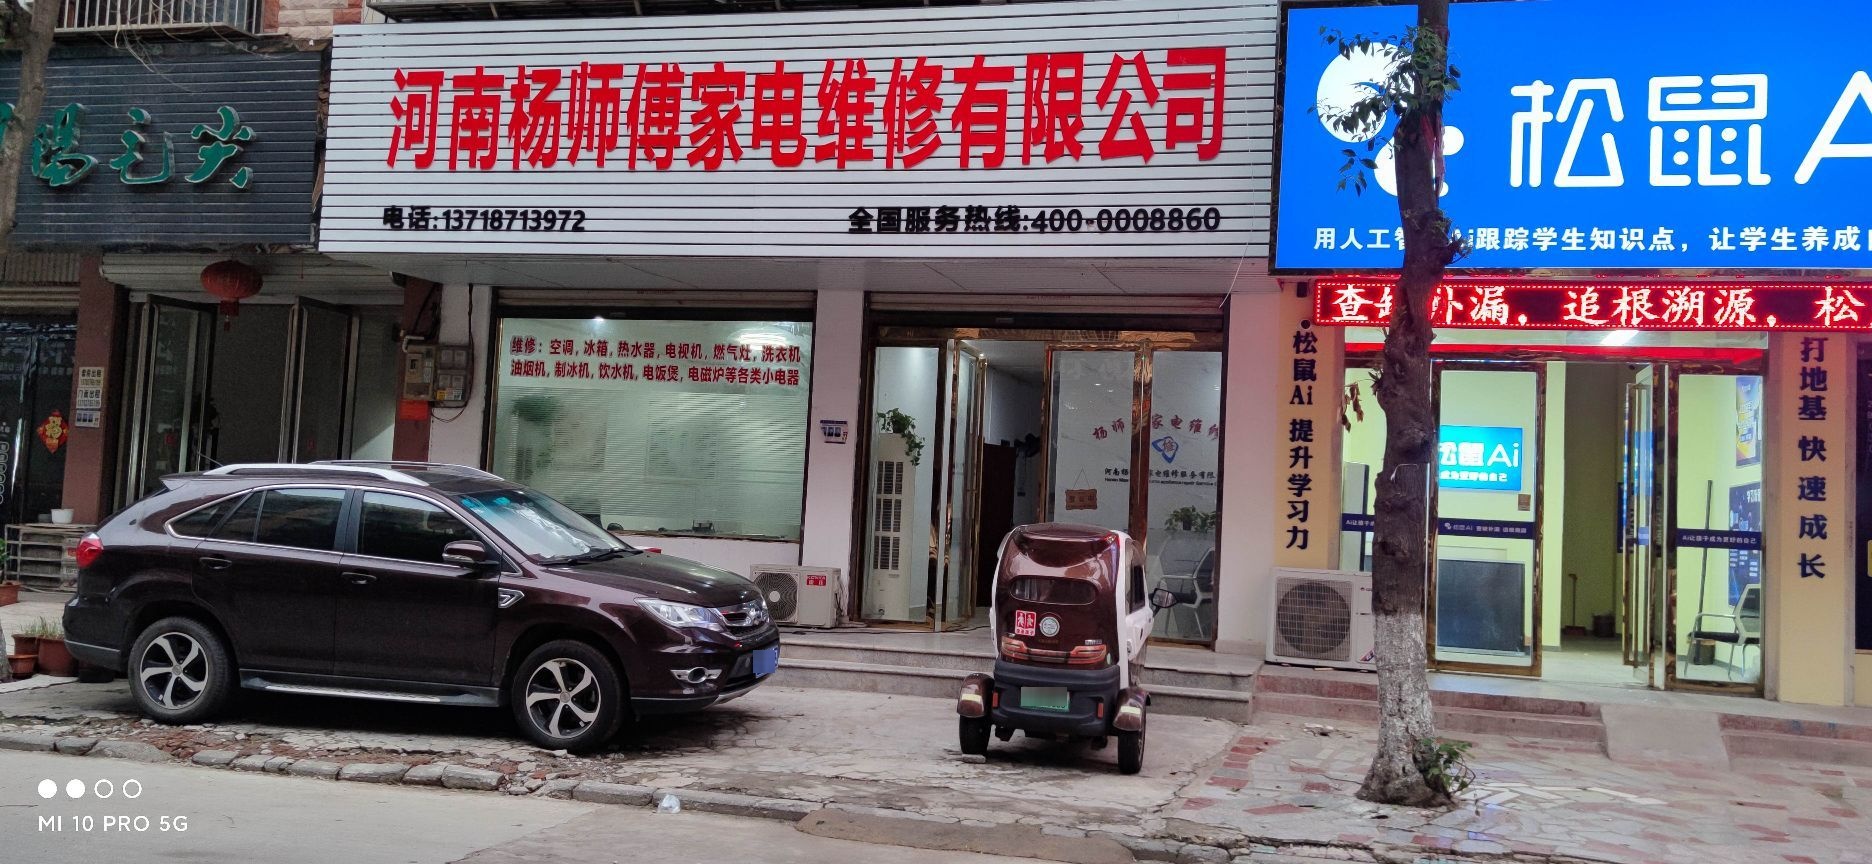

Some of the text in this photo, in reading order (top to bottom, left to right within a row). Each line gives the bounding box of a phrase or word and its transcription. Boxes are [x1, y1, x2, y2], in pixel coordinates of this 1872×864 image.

[387, 47, 1227, 171] 河南杨师傅家电维修有限公司
[382, 205, 586, 232] 电话:13718713972
[848, 204, 1221, 233] 全国服务热线:400-0008860
[1285, 330, 1319, 550] 松鼠Ai 提升学习力
[1797, 336, 1829, 580] 打地基 快速成长
